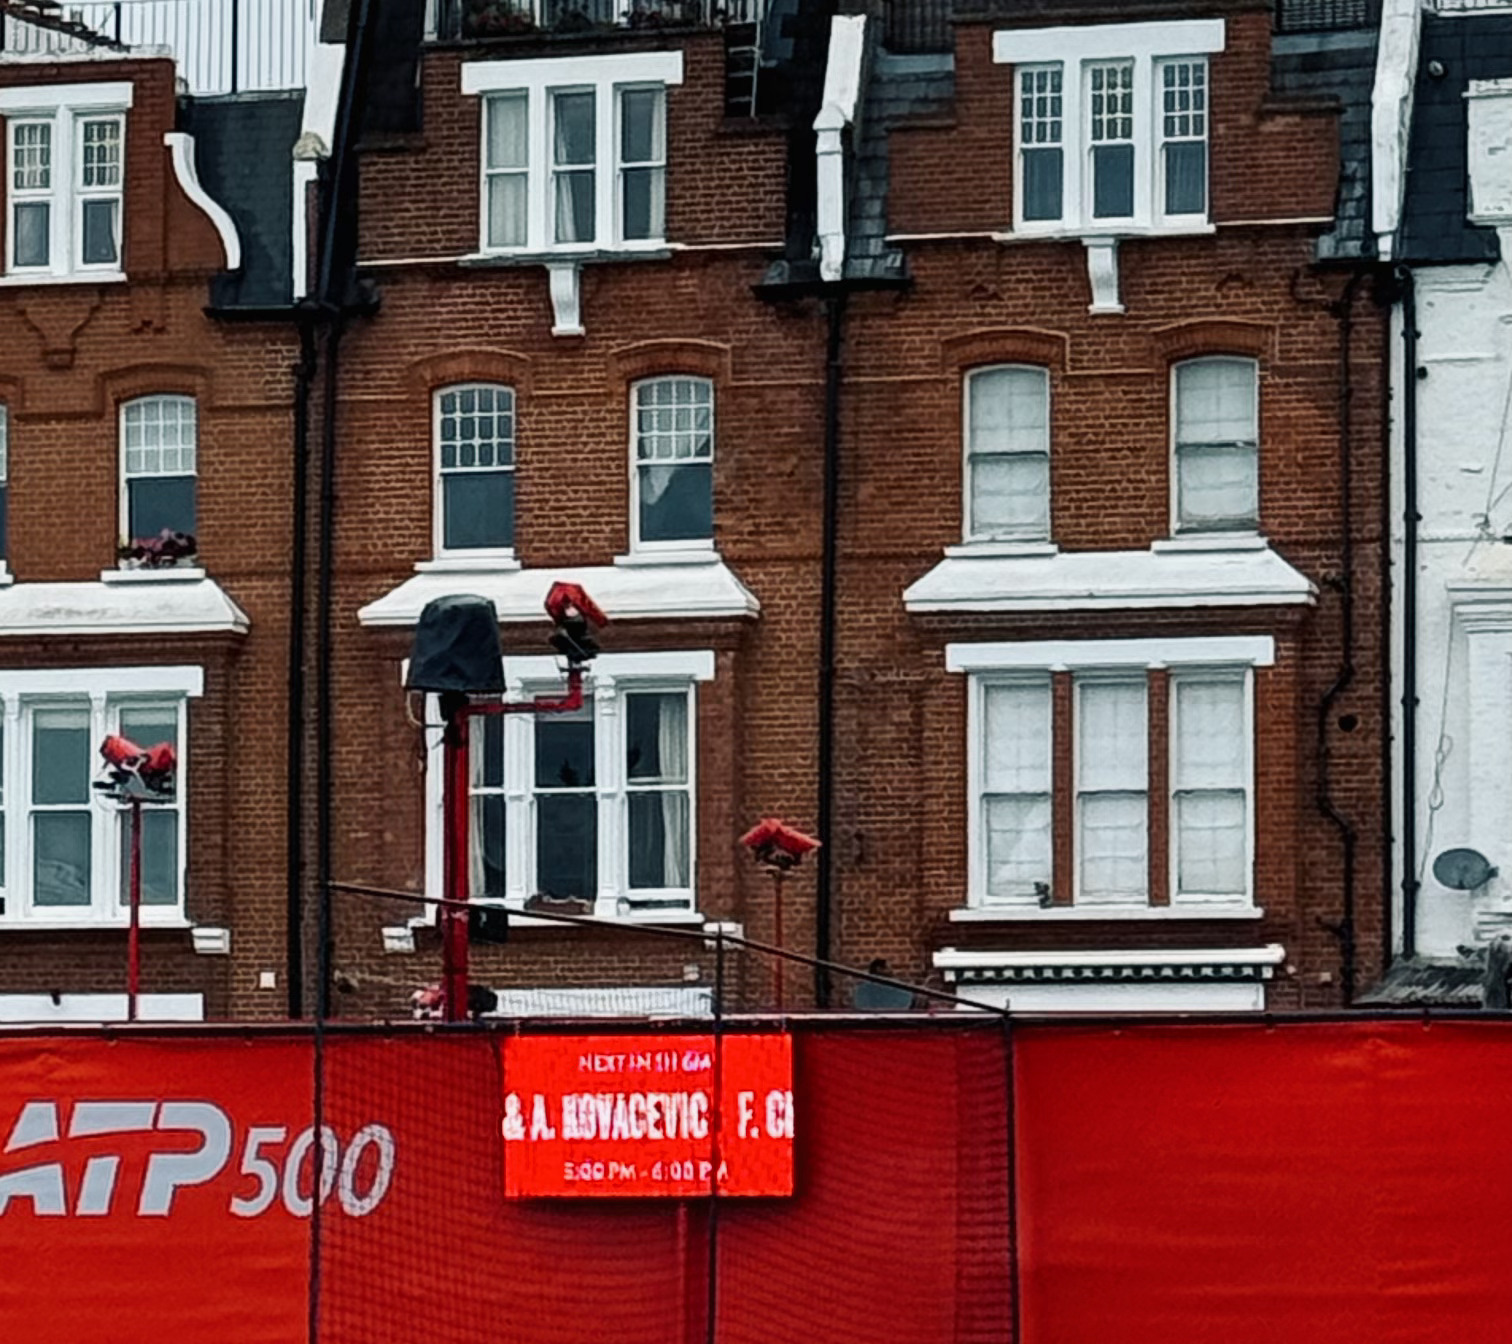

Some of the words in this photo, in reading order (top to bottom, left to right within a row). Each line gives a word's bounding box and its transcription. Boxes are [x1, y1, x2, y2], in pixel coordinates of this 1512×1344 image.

[578, 1052, 626, 1072] NEXT
[530, 1094, 556, 1140] A.
[561, 1091, 708, 1140] KOVACEVIC
[737, 1091, 759, 1139] F.
[229, 1123, 395, 1217] 500
[608, 1161, 637, 1181] PM
